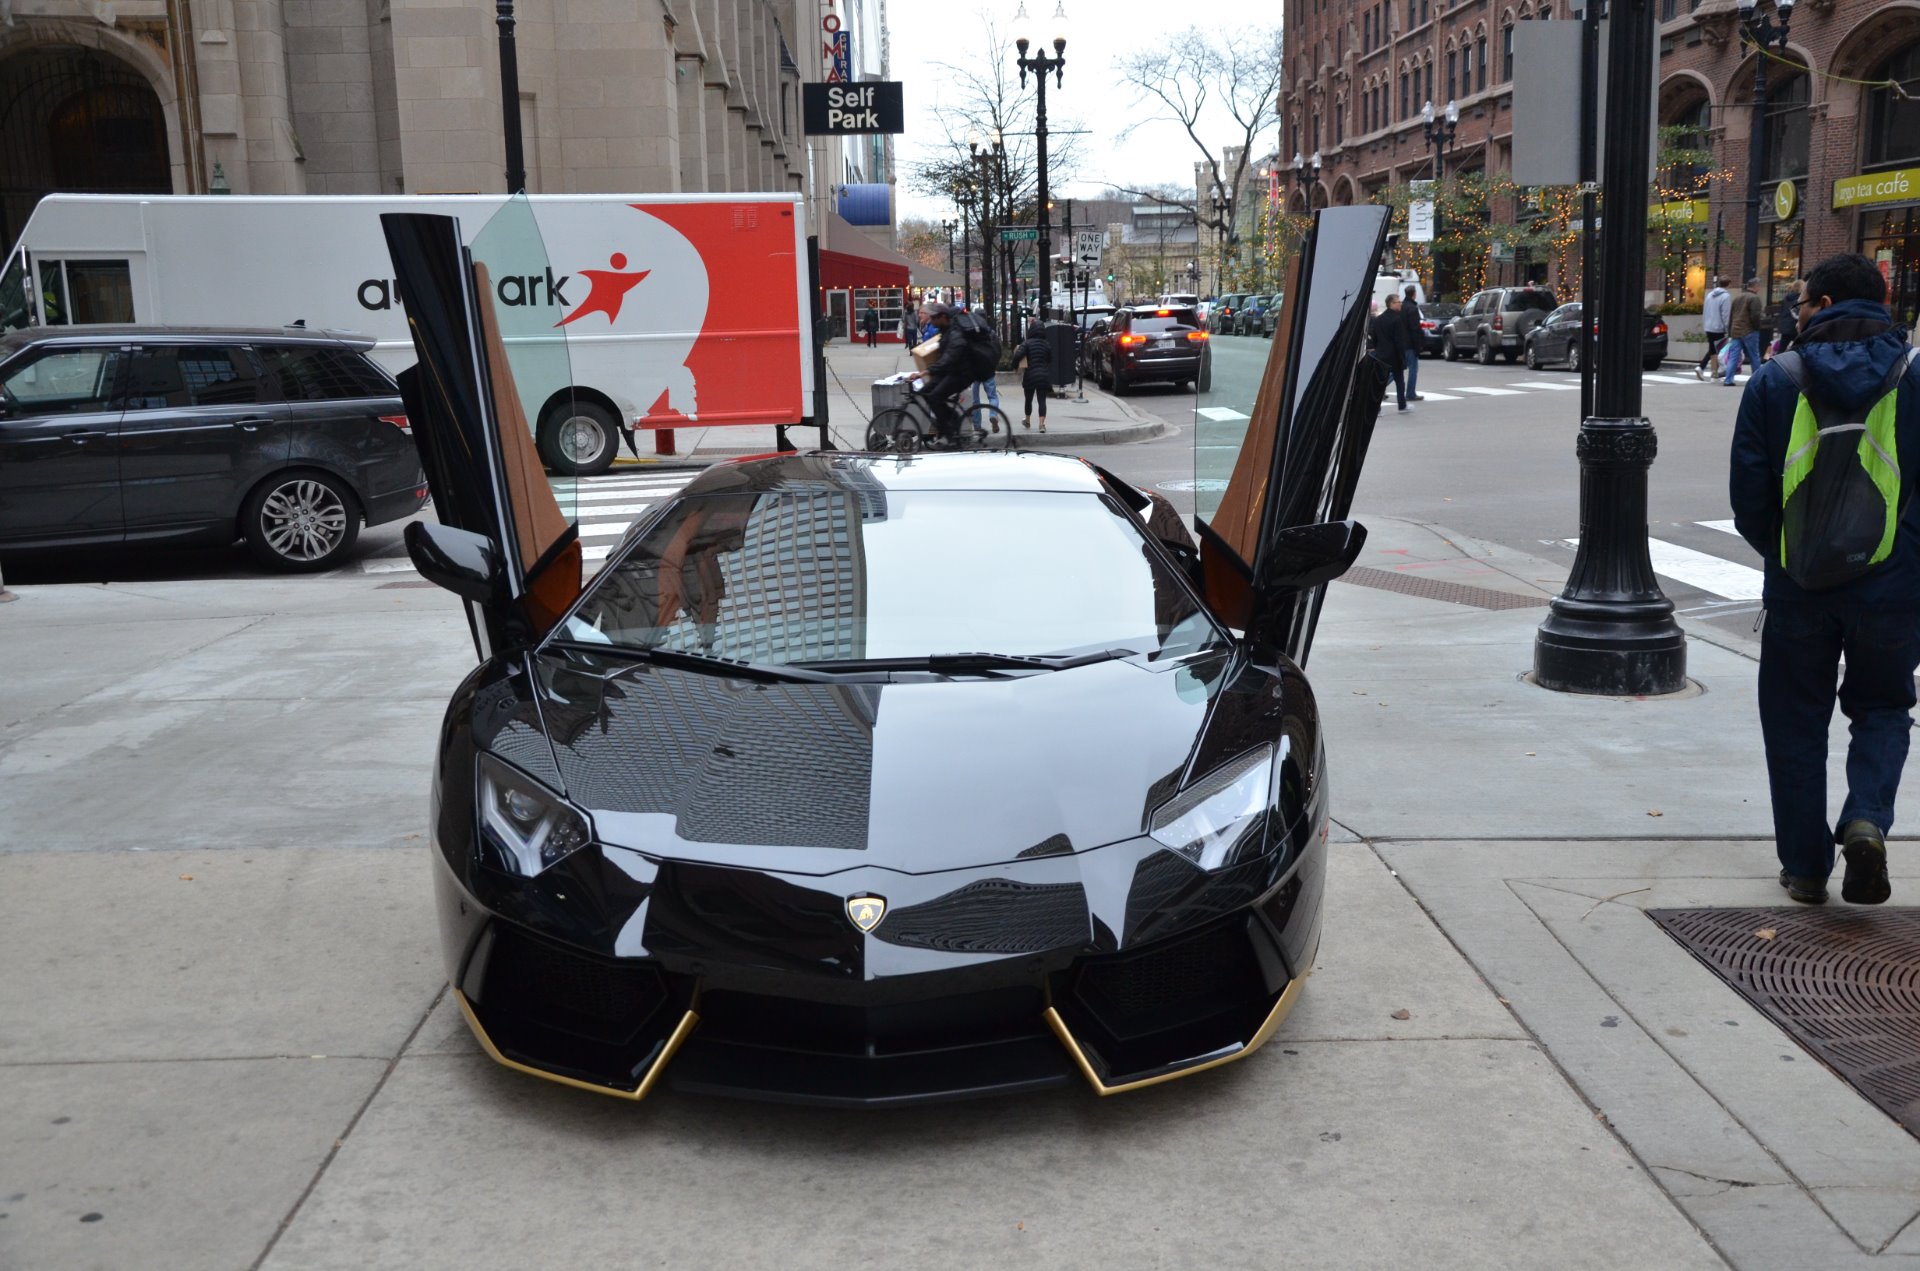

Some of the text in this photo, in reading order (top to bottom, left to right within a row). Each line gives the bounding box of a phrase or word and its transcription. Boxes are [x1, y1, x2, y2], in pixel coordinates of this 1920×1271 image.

[823, 0, 842, 83] OMA
[828, 87, 875, 107] Self
[828, 109, 879, 129] Park
[1857, 184, 1873, 197] tea
[1876, 172, 1910, 195] café
[1009, 231, 1028, 240] RUSH
[1080, 233, 1101, 244] ONE
[1080, 243, 1101, 253] WAY
